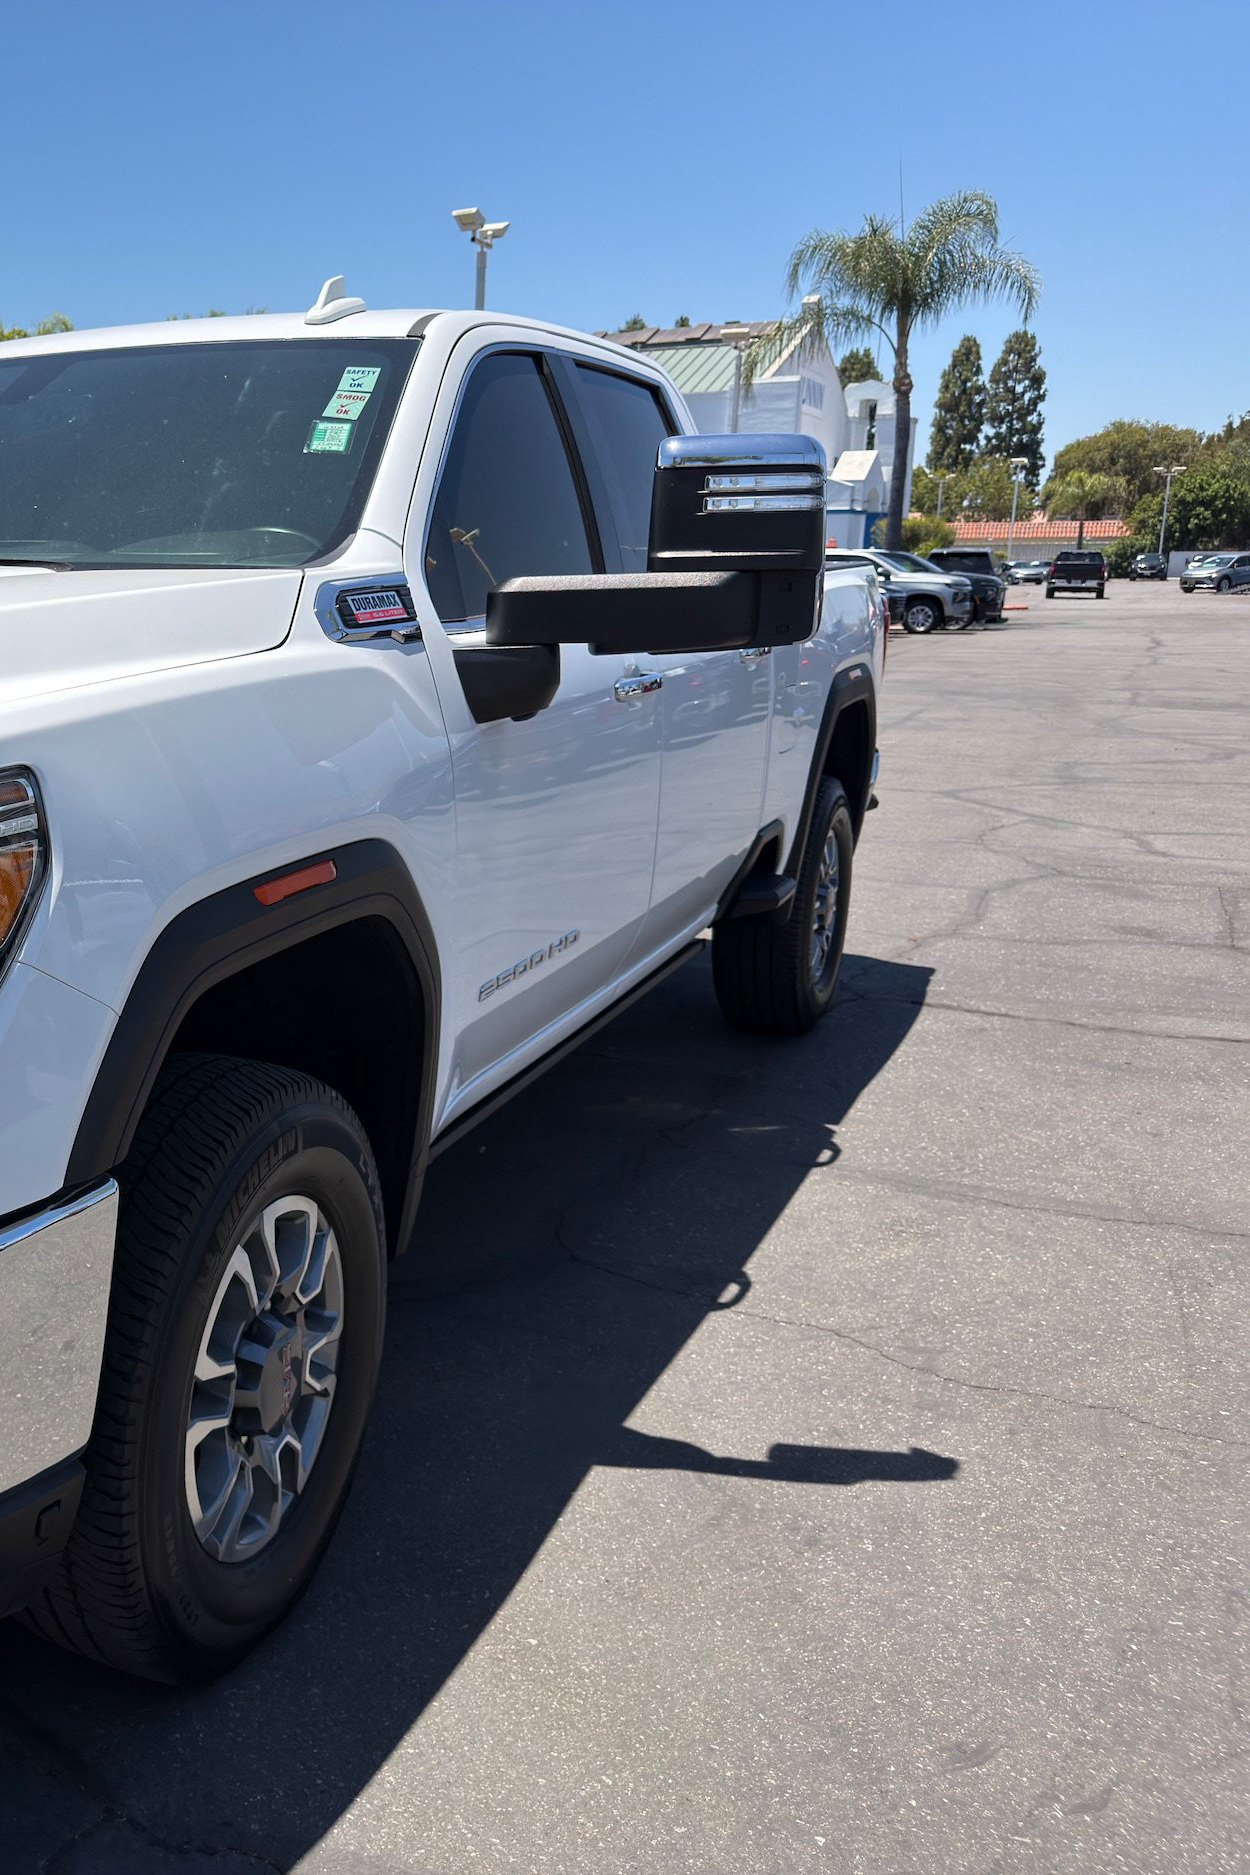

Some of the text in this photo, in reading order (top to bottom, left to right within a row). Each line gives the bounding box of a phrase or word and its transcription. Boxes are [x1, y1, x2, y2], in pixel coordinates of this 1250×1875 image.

[350, 593, 400, 612] DURAMAX
[477, 929, 581, 1003] 2500 HD
